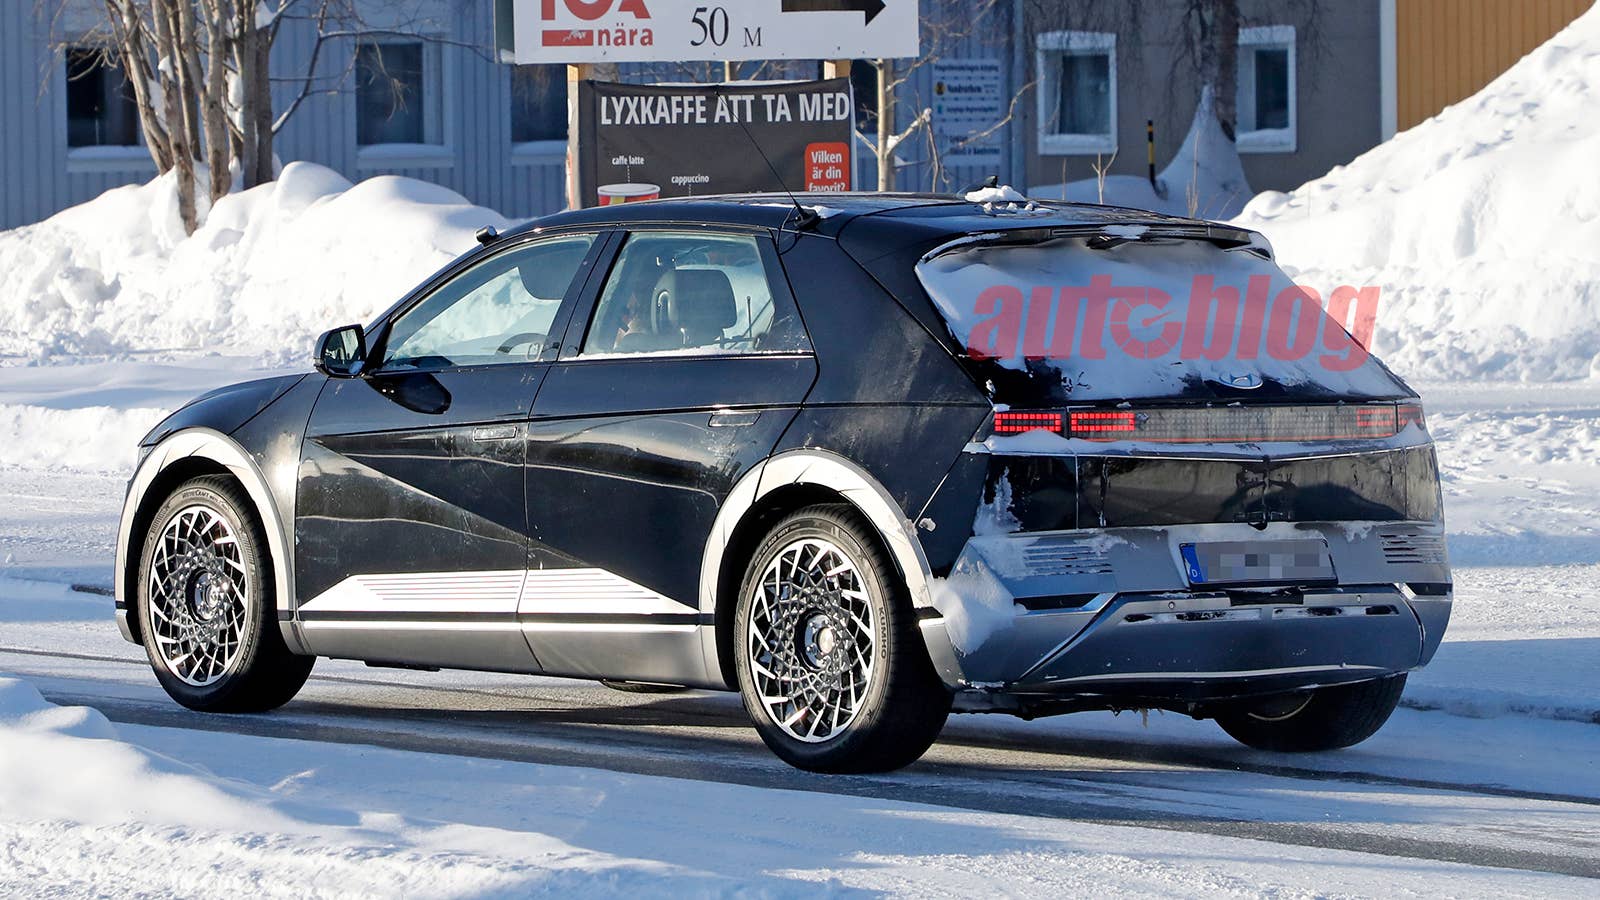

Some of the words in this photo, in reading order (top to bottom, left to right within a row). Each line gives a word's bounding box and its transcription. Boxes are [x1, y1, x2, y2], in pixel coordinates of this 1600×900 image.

[597, 22, 654, 46] nära
[690, 6, 729, 46] 50
[743, 26, 762, 47] M
[601, 95, 707, 125] LYXKAFFE
[713, 94, 756, 123] ATT
[761, 93, 792, 122] TA
[798, 92, 850, 122] MED
[611, 155, 628, 166] caffe
[628, 155, 645, 165] latte
[811, 150, 843, 164] Vilken
[671, 173, 710, 186] cappuccino
[812, 166, 823, 180] är
[825, 165, 842, 179] din
[879, 607, 887, 660] KUMHO
